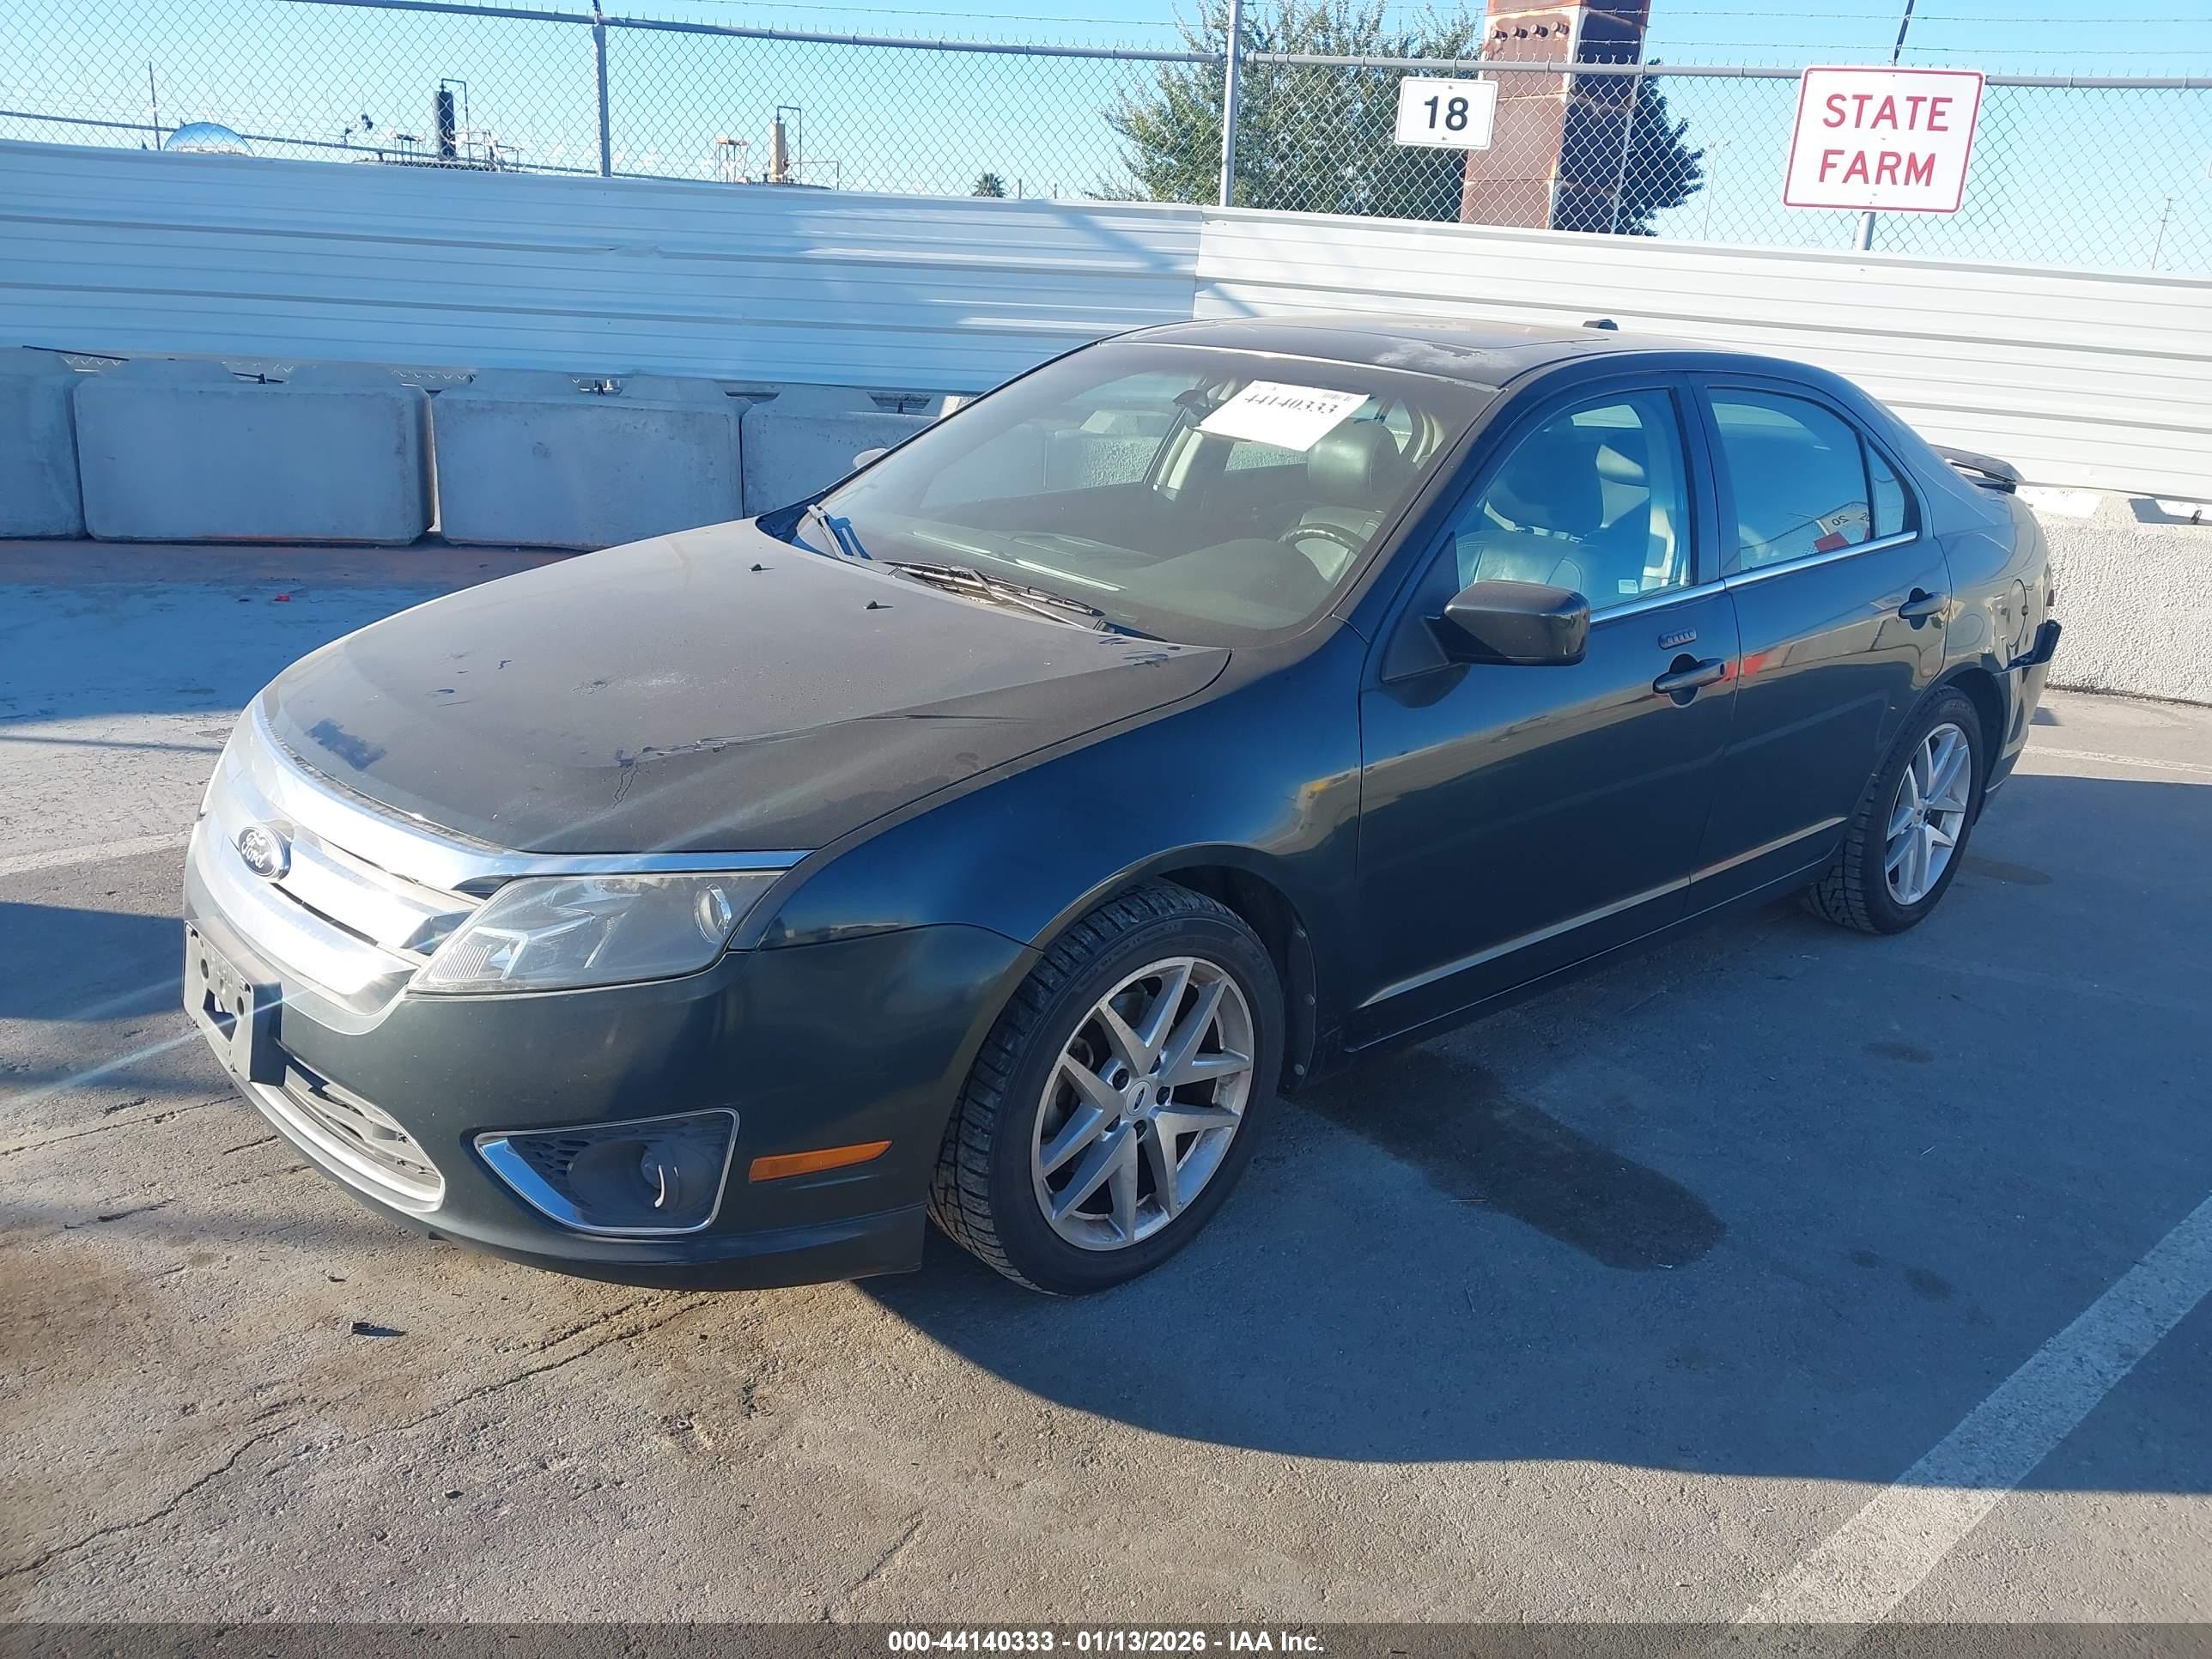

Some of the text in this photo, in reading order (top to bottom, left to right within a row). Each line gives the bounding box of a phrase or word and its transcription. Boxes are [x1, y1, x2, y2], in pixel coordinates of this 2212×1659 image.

[1424, 96, 1469, 131] 18
[1822, 94, 1954, 131] STATE
[1818, 149, 1936, 187] FARM
[240, 830, 268, 869] Ford
